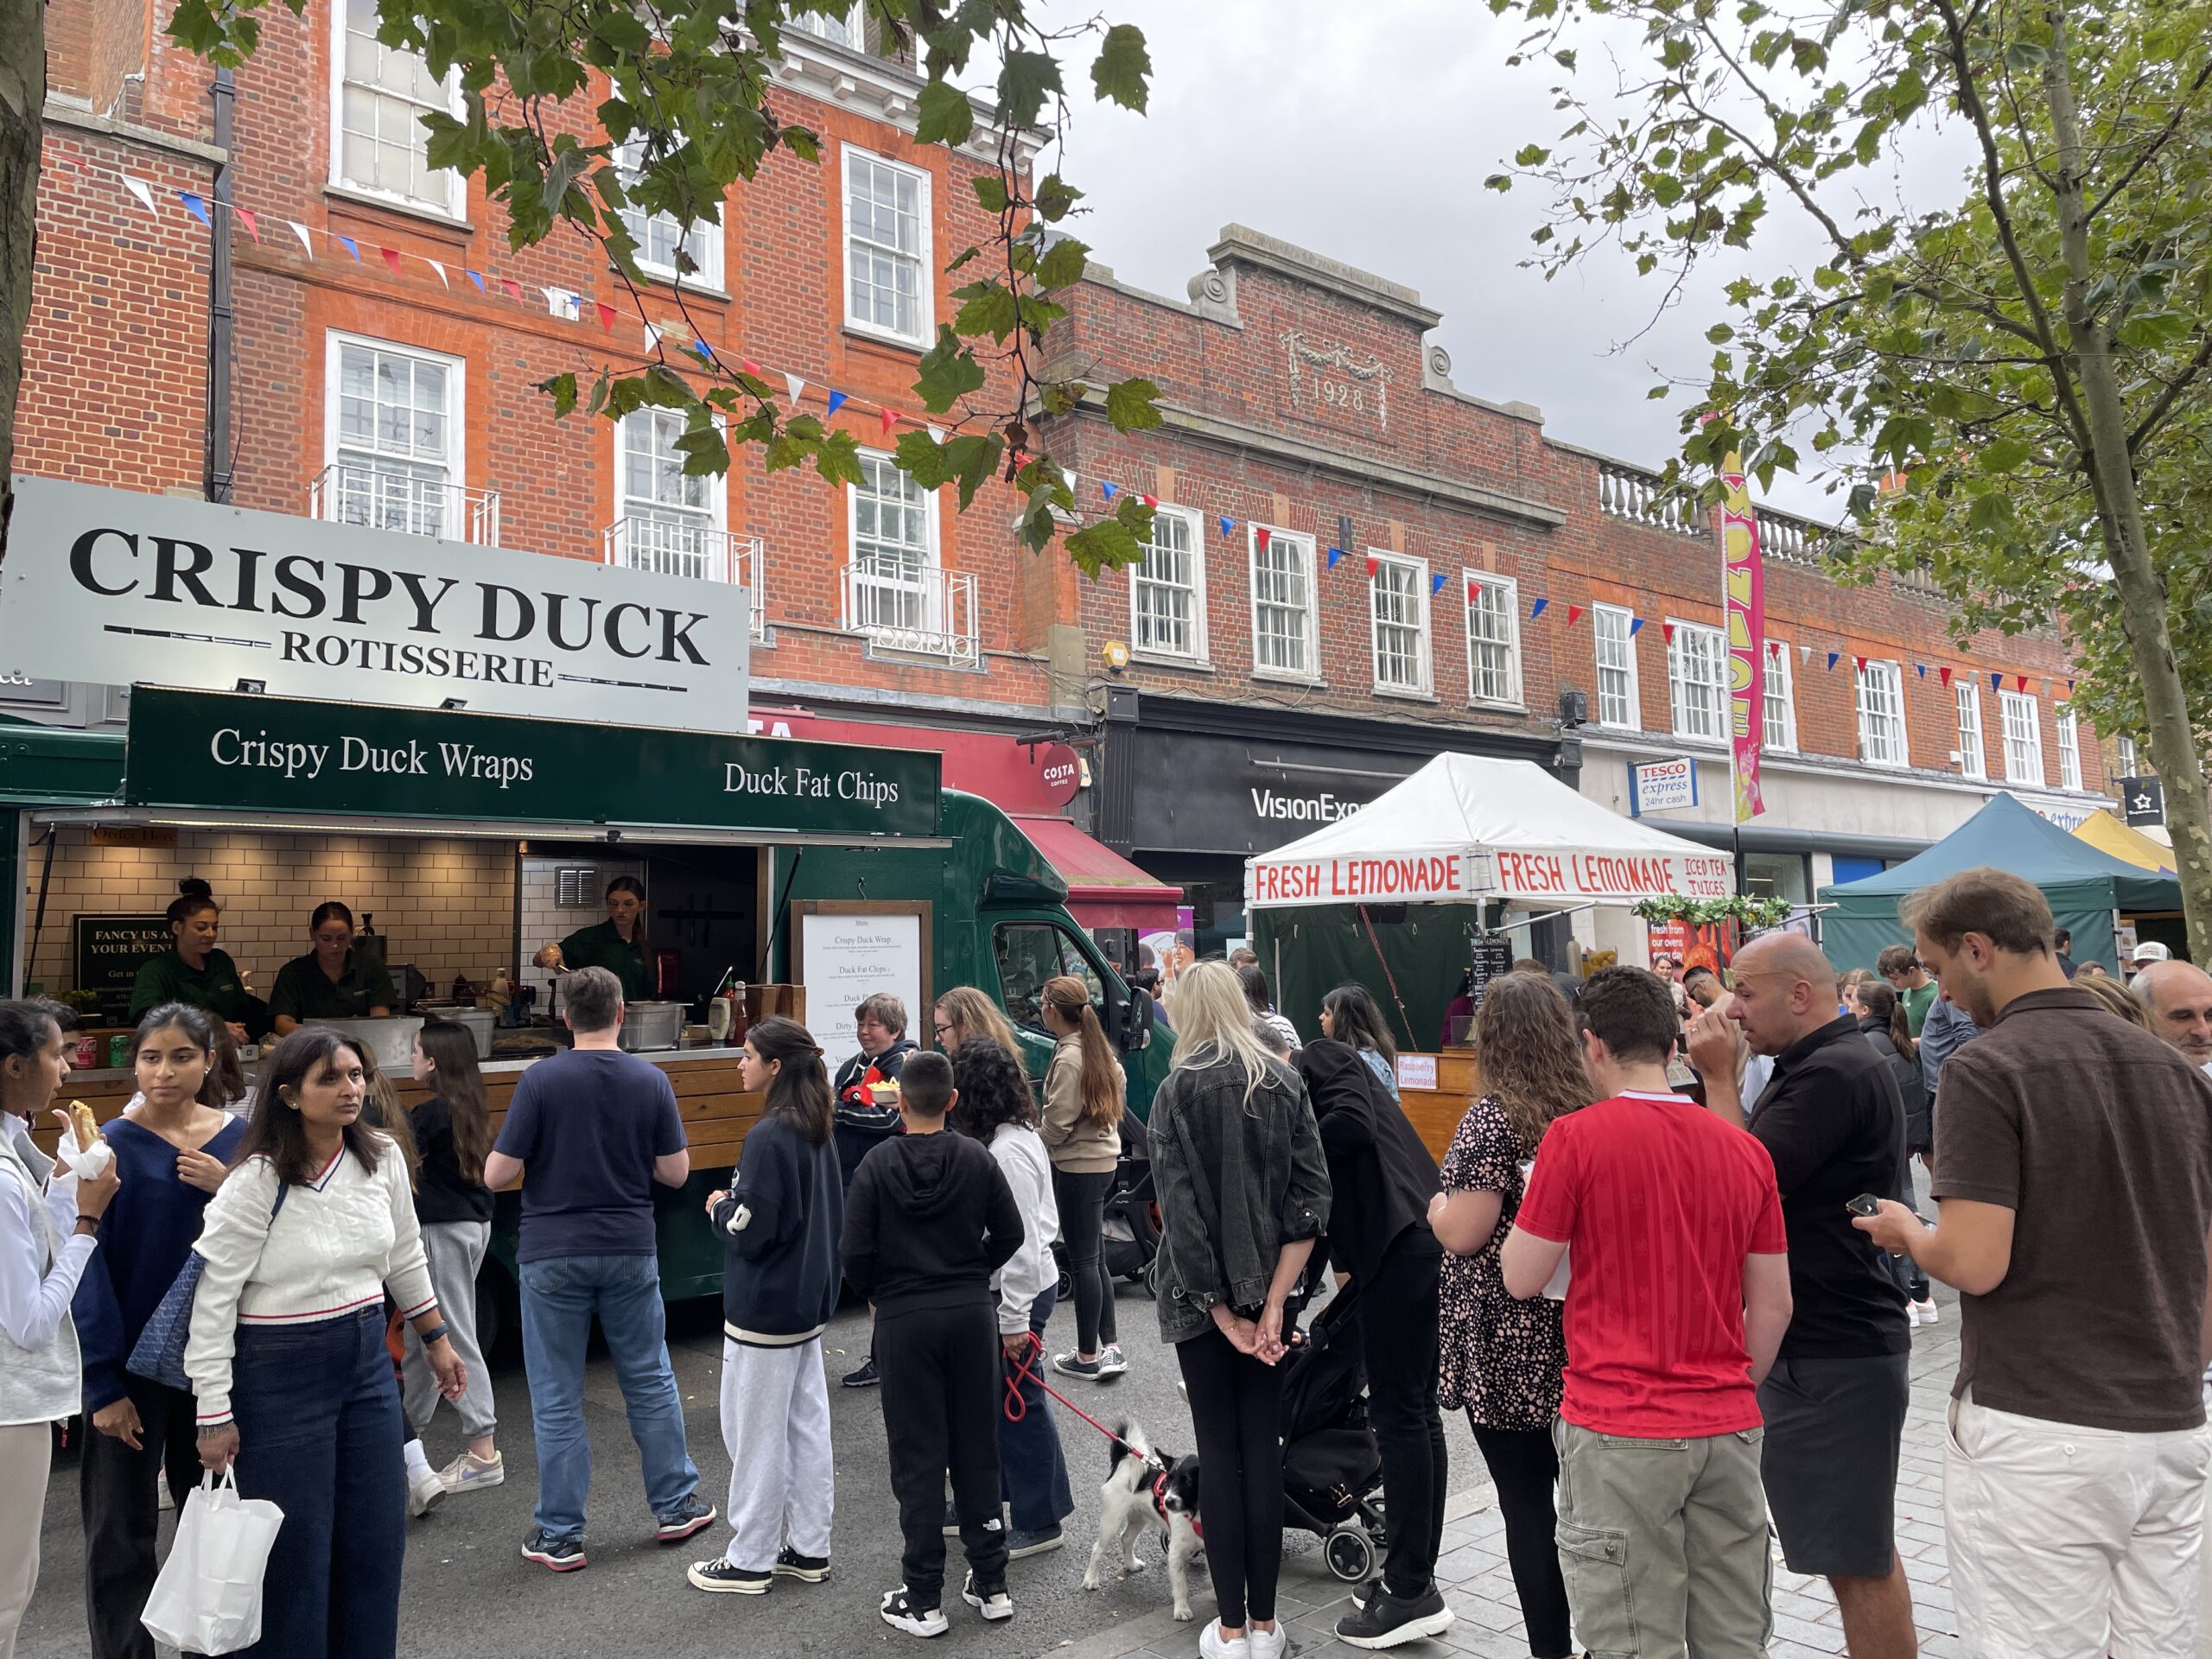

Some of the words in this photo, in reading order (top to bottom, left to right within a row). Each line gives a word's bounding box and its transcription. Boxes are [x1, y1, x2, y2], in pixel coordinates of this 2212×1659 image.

[1313, 378, 1363, 411] 1928
[69, 528, 459, 634] CRISPY
[474, 582, 710, 666] DUCK
[279, 630, 554, 688] ROTISSERIE
[210, 728, 329, 779] Crispy
[340, 735, 429, 775] Duck
[437, 742, 533, 789] Wraps
[1044, 764, 1075, 780] COSTA
[1641, 763, 1687, 778] TESCO
[723, 762, 788, 795] Duck
[794, 767, 831, 798] Fat
[837, 771, 899, 809] Chips
[1051, 779, 1068, 787] COFFEE
[1643, 781, 1688, 795] express
[1251, 787, 1369, 822] VisionExp
[1645, 797, 1664, 806] 24hr
[1666, 794, 1687, 804] cash
[1255, 864, 1321, 900] FRESH
[1332, 855, 1461, 896] LEMONADE
[1497, 852, 1567, 893] FRESH
[1571, 854, 1678, 893] LEMONADE
[1684, 858, 1707, 876] ICED
[1709, 858, 1727, 877] TEA
[1688, 880, 1726, 895] JUICES
[95, 931, 138, 940] FANCY
[142, 930, 157, 939] US
[1650, 923, 1668, 934] fresh
[1669, 924, 1685, 934] from
[835, 936, 855, 945] Crispy
[875, 936, 892, 944] Wrap
[1664, 939, 1684, 948] ovens
[91, 944, 128, 954] YOUR
[1671, 950, 1684, 962] day
[108, 969, 124, 978] Get
[868, 965, 887, 974] Chips
[836, 1022, 852, 1031] Dirty
[1399, 1061, 1434, 1074] Raspberry
[1400, 1075, 1437, 1086] Lemonade
